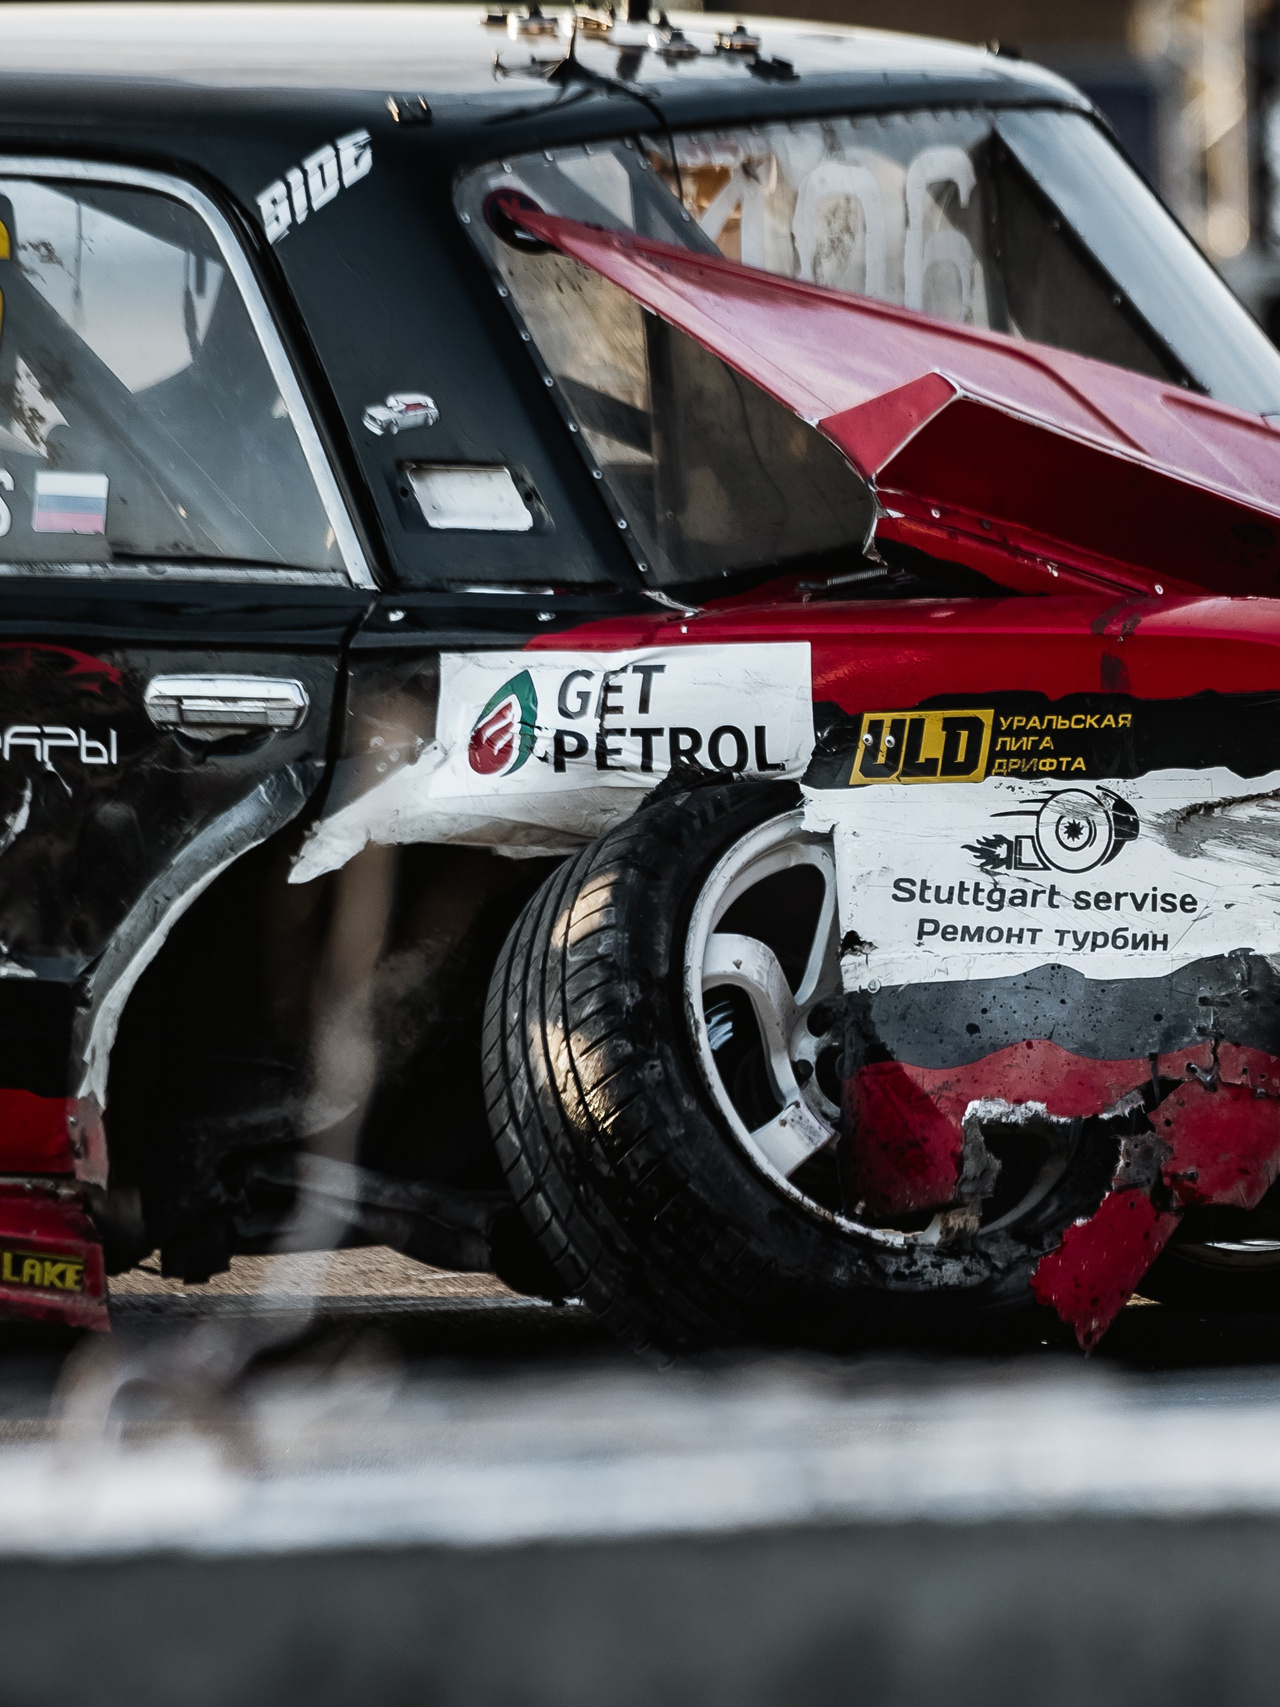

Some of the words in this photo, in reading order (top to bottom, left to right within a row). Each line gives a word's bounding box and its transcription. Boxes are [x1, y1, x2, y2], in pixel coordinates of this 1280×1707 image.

[557, 664, 667, 720] GET
[999, 713, 1132, 731] УРАЛЬСКАЯ
[0, 725, 118, 765] АРЫ
[553, 725, 786, 773] PETROL
[857, 715, 987, 778] ULD
[995, 736, 1054, 752] ЛИГА
[991, 757, 1087, 776] ДРИФТА
[891, 877, 1062, 912] Stuttgart
[1074, 886, 1199, 914] servise
[916, 918, 1043, 945] Ремонт
[1055, 926, 1169, 952] турбин
[3, 1251, 84, 1292] LAKE
